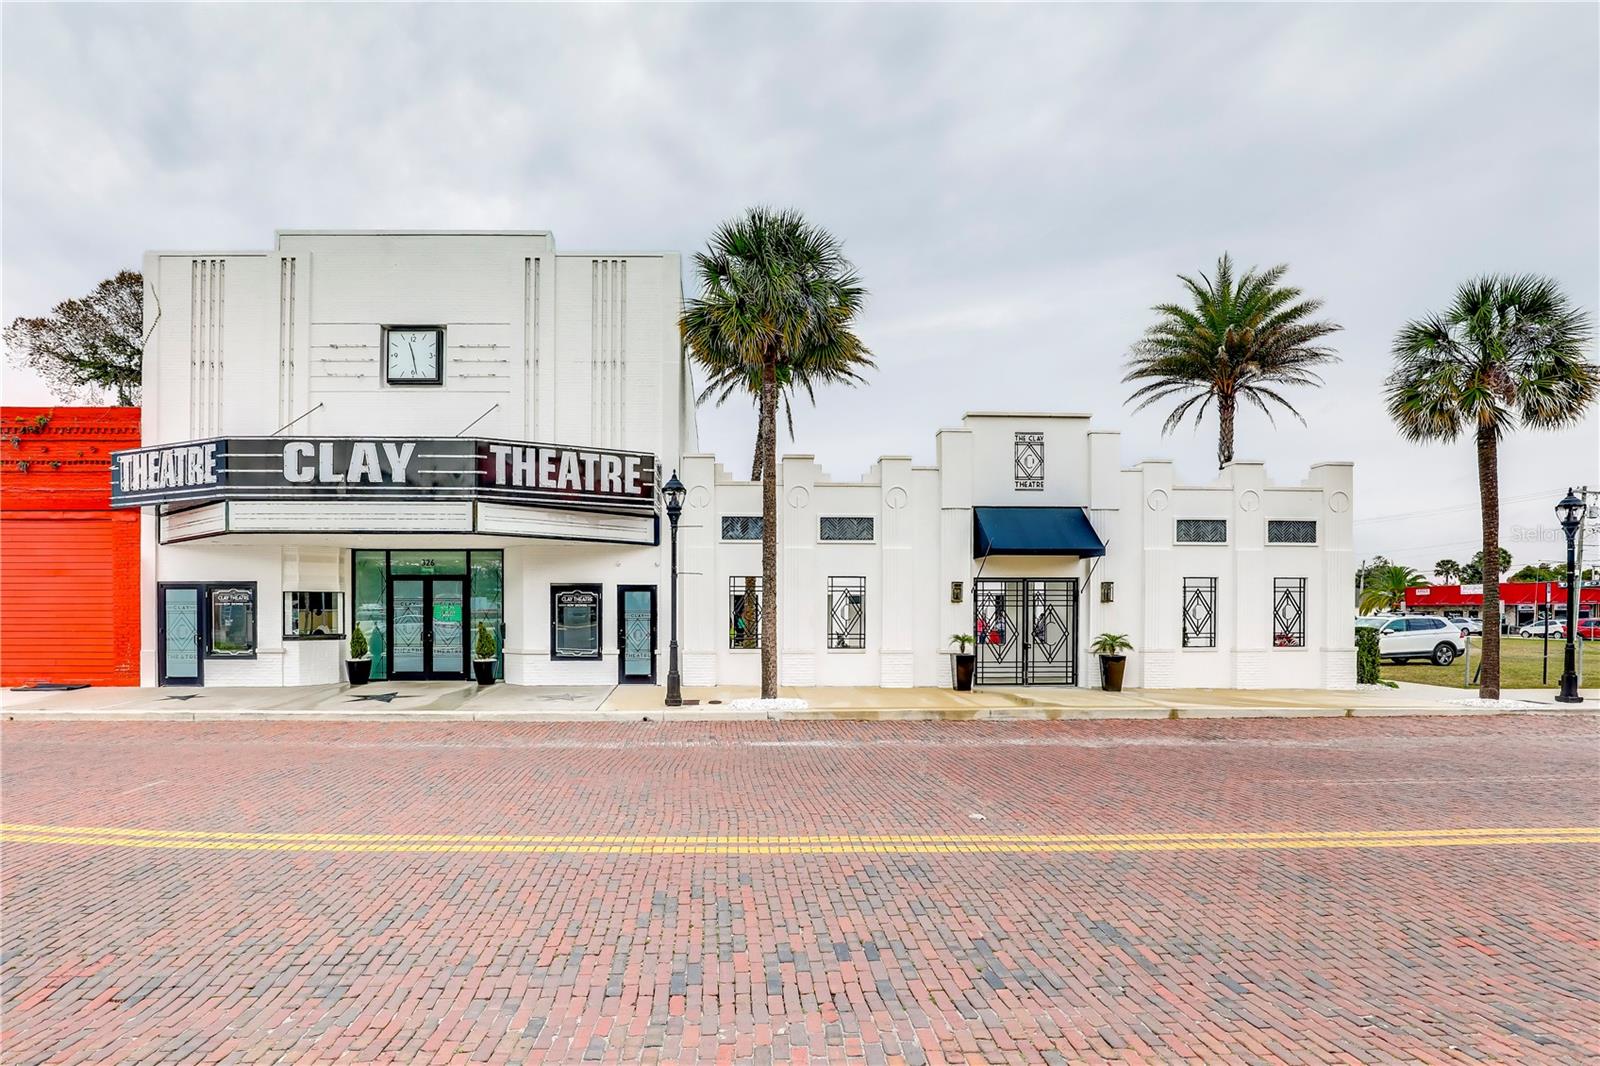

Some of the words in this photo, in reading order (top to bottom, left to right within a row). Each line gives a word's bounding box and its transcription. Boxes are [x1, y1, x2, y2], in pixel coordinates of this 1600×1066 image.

[117, 443, 217, 492] THEATRE
[282, 442, 416, 483] CLAY
[489, 444, 642, 494] THEATRE
[421, 559, 435, 567] 326
